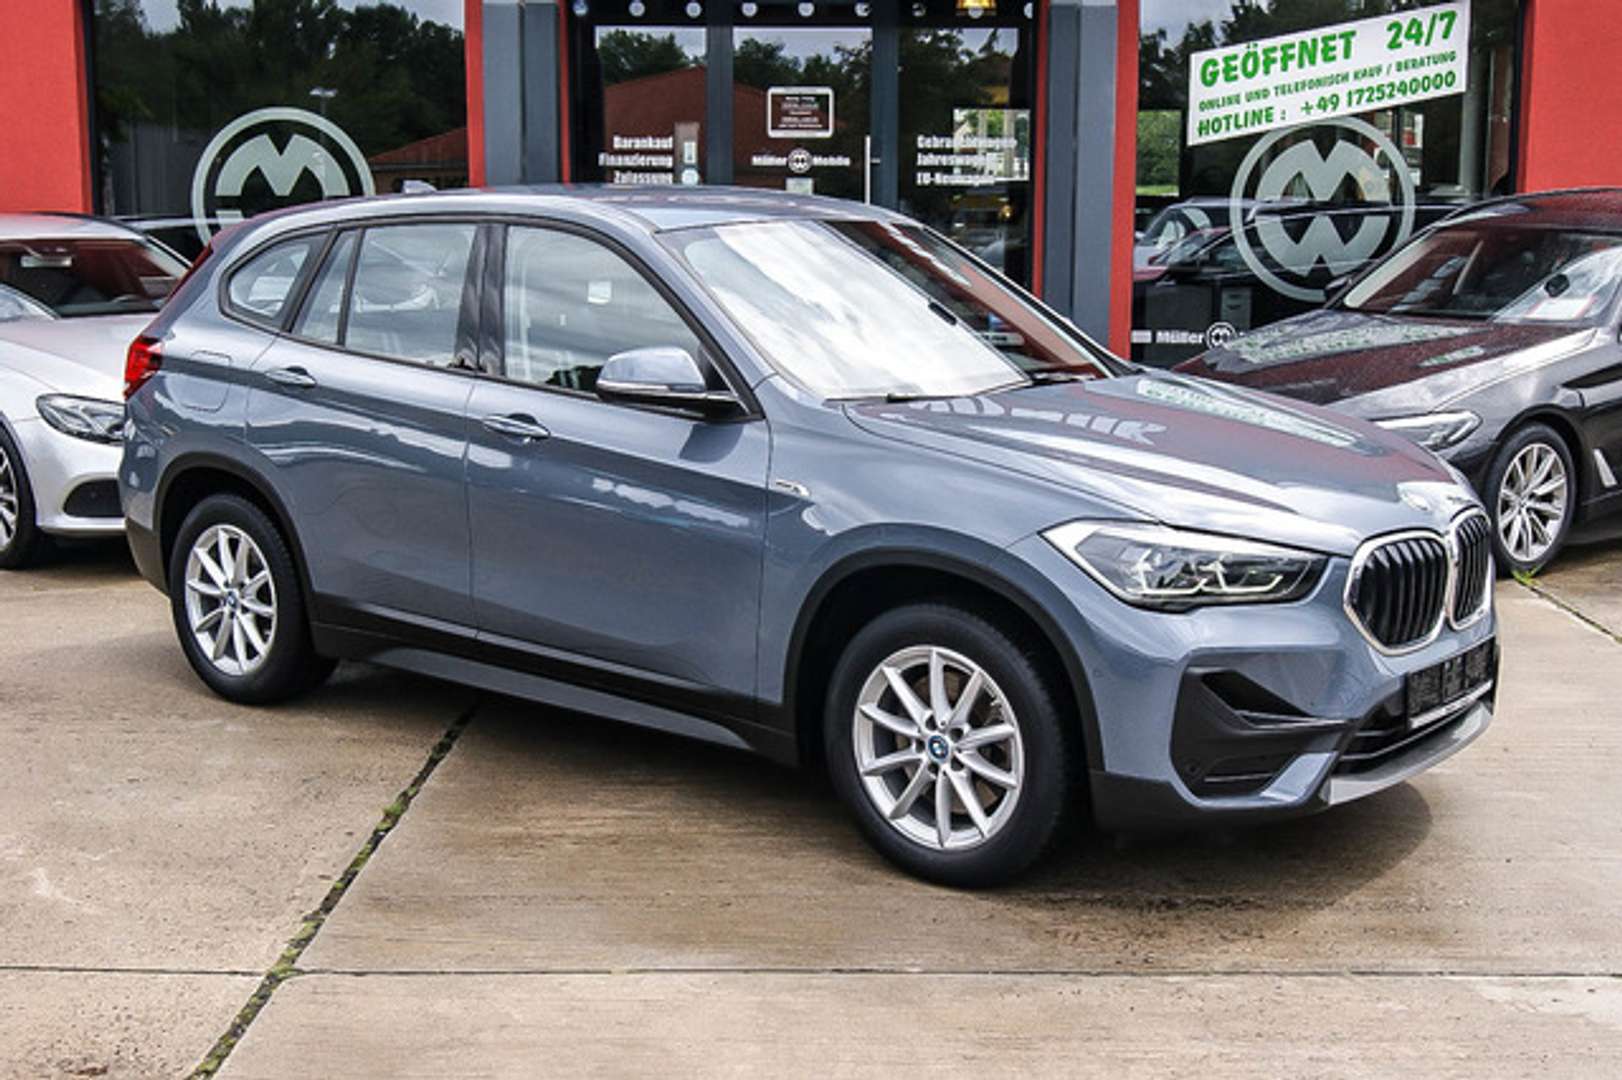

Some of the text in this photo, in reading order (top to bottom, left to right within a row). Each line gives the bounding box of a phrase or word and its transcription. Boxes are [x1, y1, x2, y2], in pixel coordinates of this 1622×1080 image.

[1200, 10, 1457, 87] GEÖFFNET 24/7
[1197, 106, 1275, 137] HOTLINE
[1301, 93, 1340, 115] +49
[1346, 70, 1456, 107] 1725240000
[1199, 93, 1241, 112] ONLINE
[1245, 88, 1270, 102] UND
[1274, 71, 1349, 97] TELEFONISCH
[1353, 64, 1382, 80] KAUF
[1396, 50, 1456, 72] BERATUNG
[598, 152, 673, 168] Finanzierung
[1156, 329, 1204, 344] Müller
